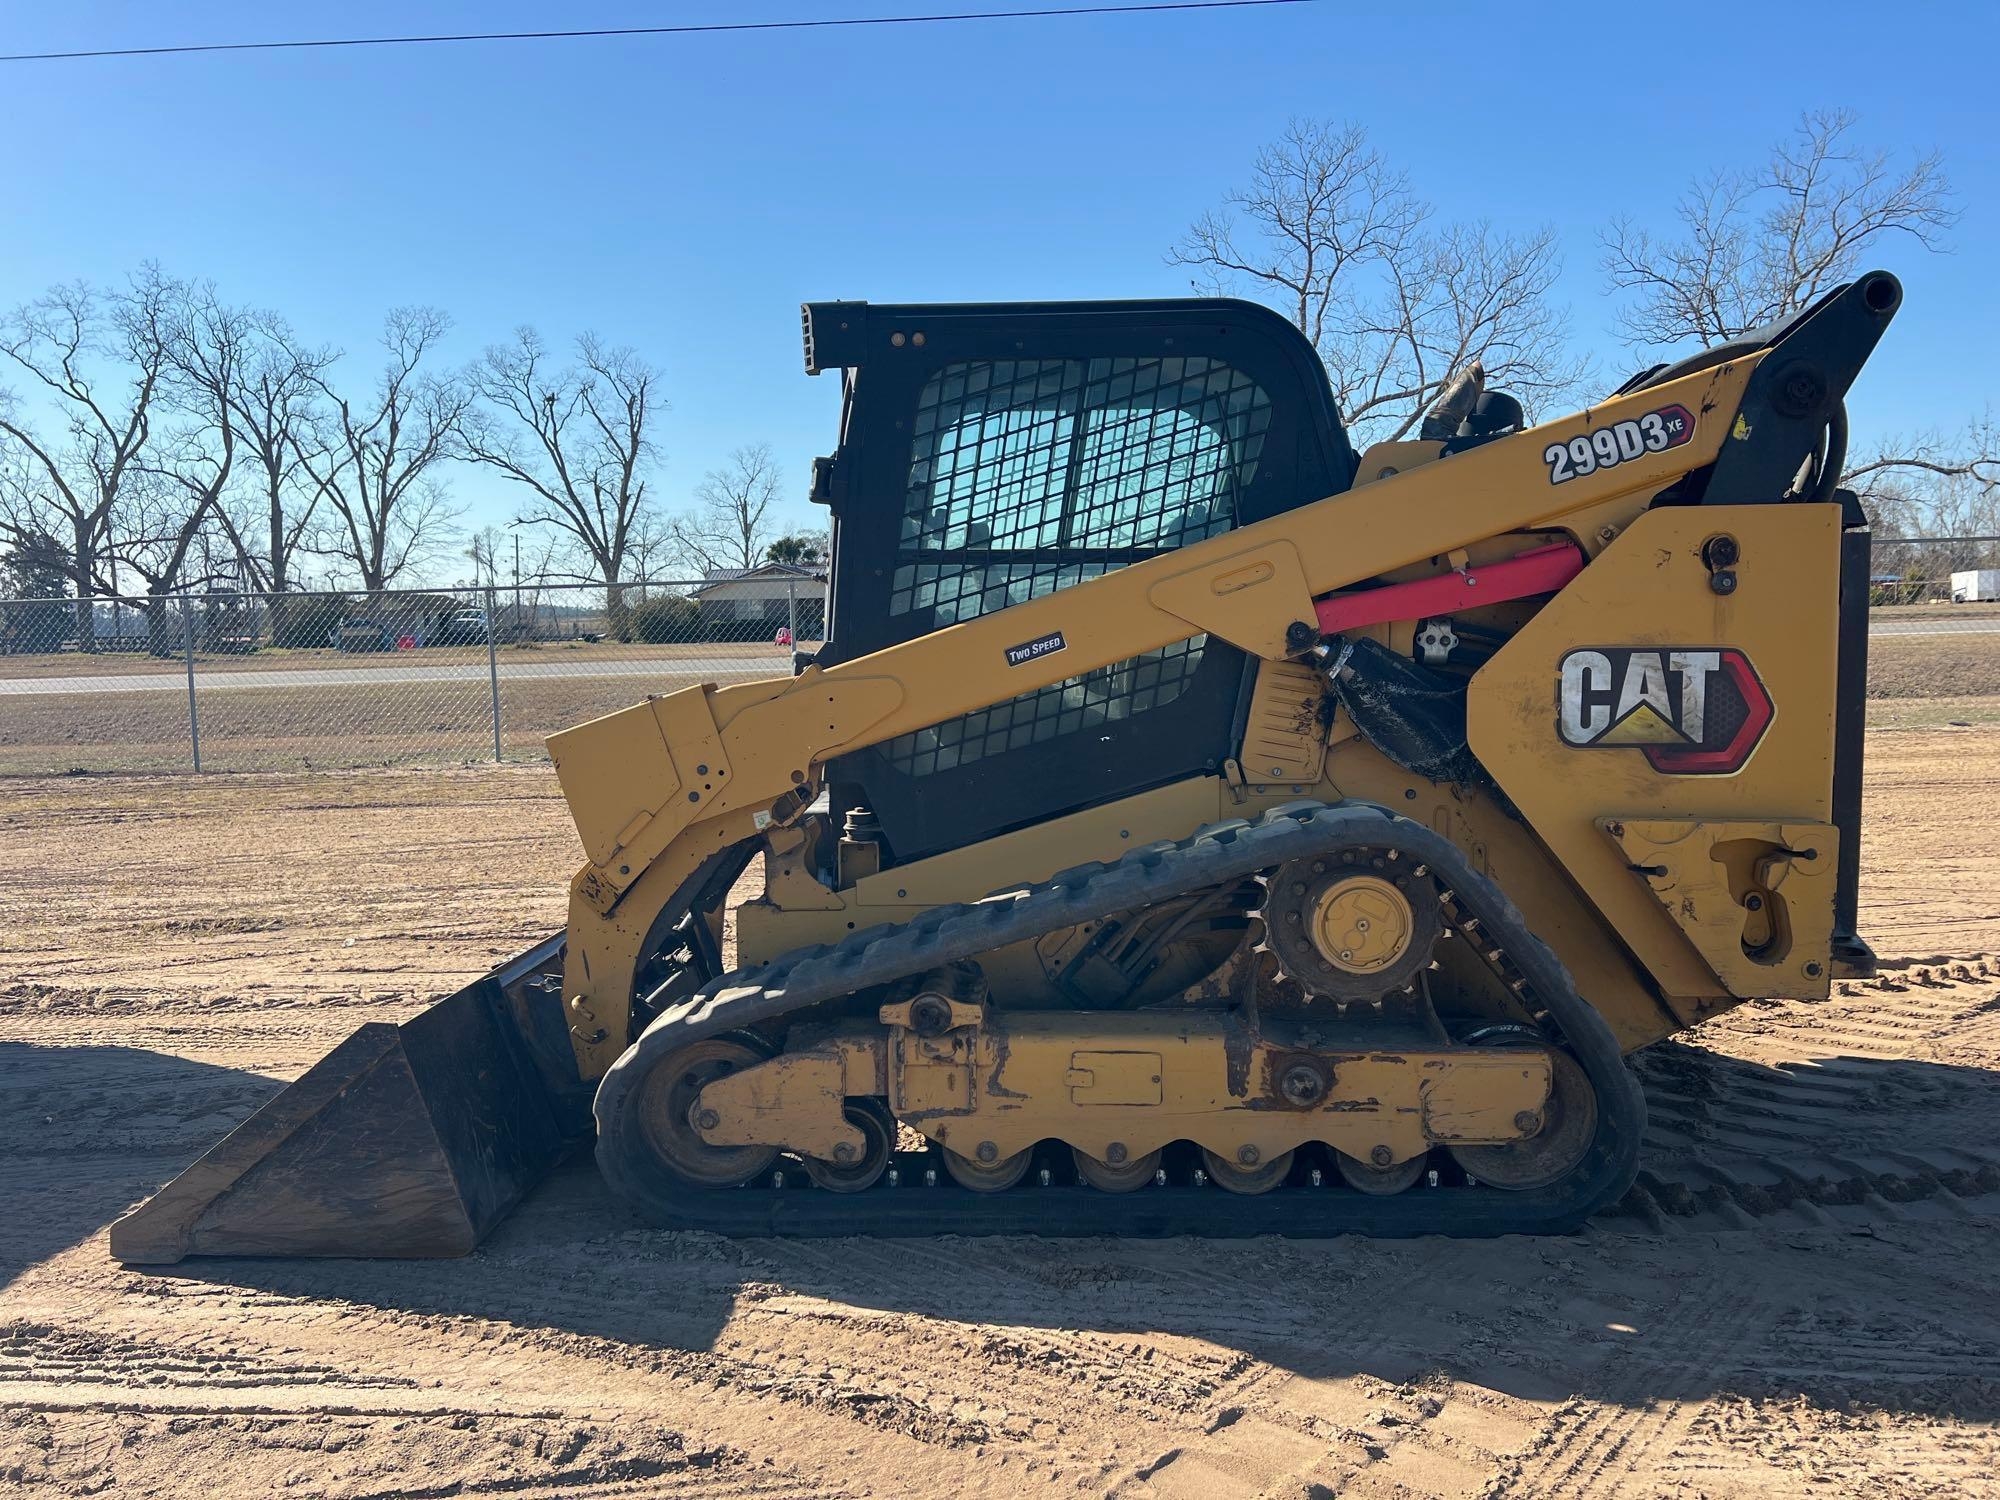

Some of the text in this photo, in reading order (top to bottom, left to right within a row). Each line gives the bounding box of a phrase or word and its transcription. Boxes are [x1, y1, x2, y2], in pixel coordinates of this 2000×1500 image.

[1545, 413, 1683, 484] 299D3 XE
[1561, 651, 1720, 744] CAT
